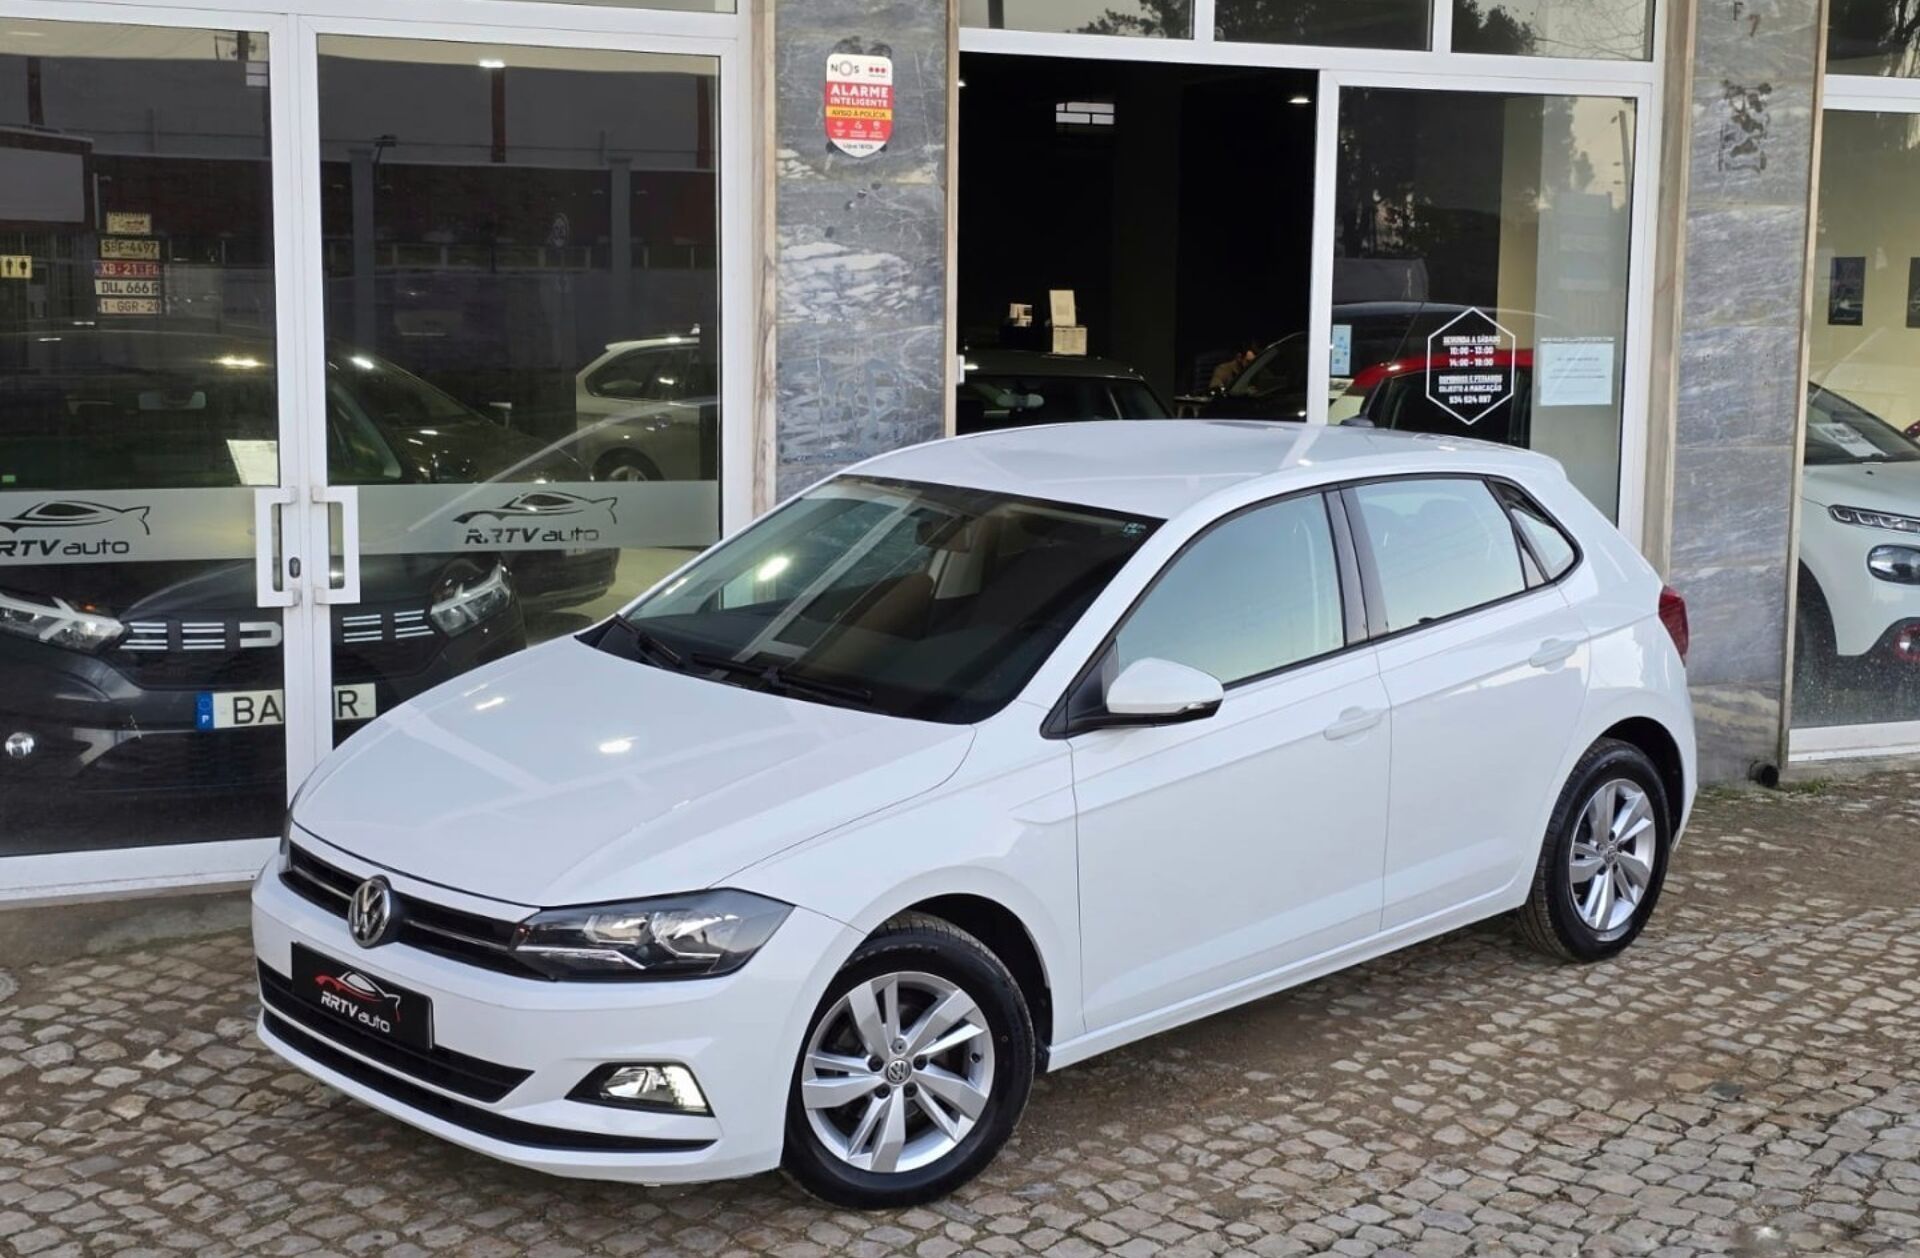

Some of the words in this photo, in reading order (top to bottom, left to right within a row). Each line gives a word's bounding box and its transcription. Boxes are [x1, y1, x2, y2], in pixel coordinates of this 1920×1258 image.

[830, 84, 889, 98] ALARME
[830, 97, 888, 107] INTELIGENTE
[542, 527, 599, 542] auto
[62, 539, 130, 555] auto
[320, 990, 358, 1017] RRTV
[358, 1012, 390, 1032] auto
